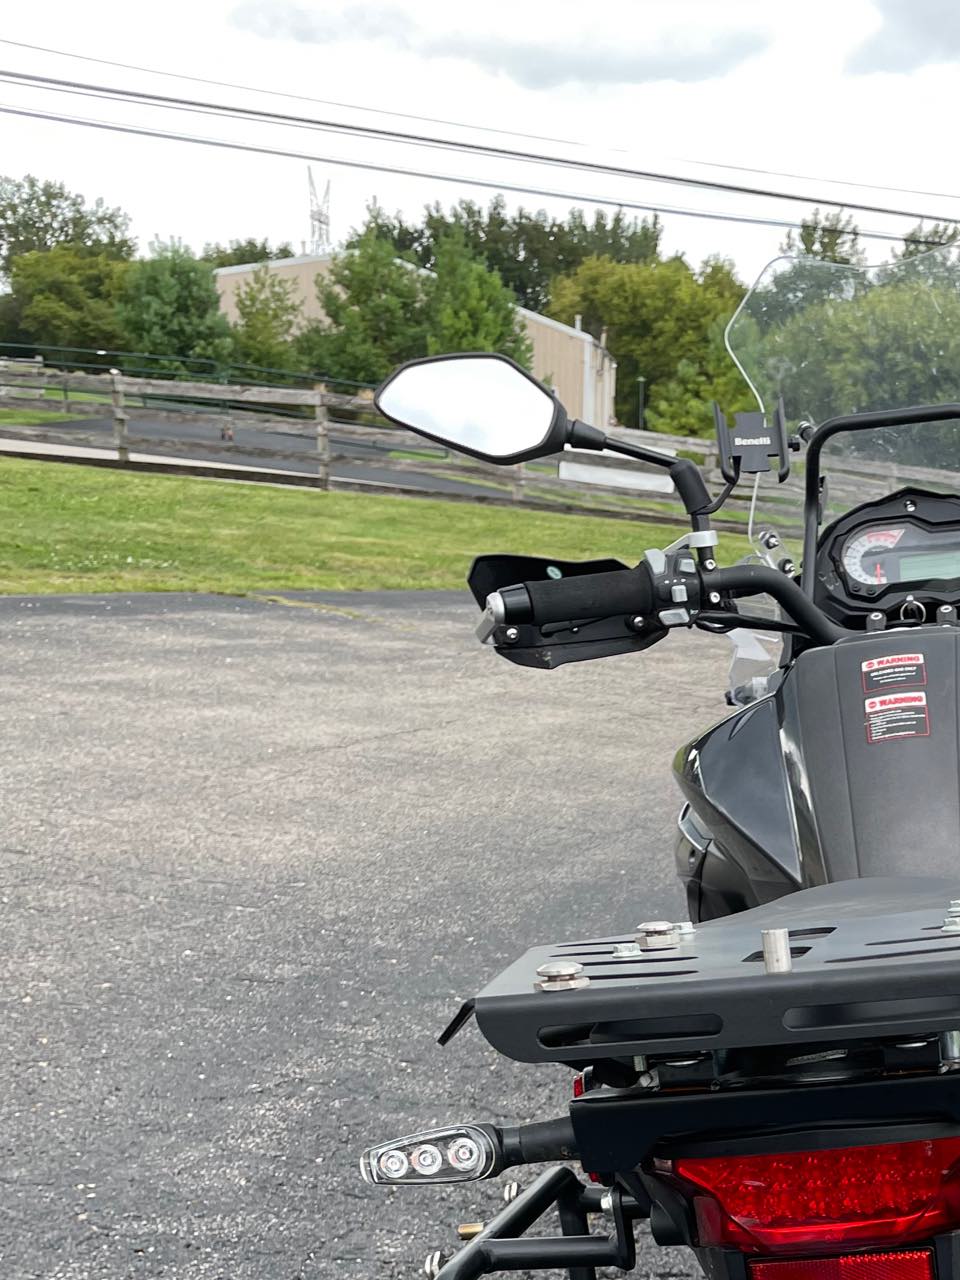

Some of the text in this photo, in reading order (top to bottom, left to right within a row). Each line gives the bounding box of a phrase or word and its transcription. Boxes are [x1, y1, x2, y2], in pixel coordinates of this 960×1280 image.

[735, 437, 770, 445] Benelli
[877, 656, 920, 666] WARNING
[879, 696, 923, 706] WARNING
